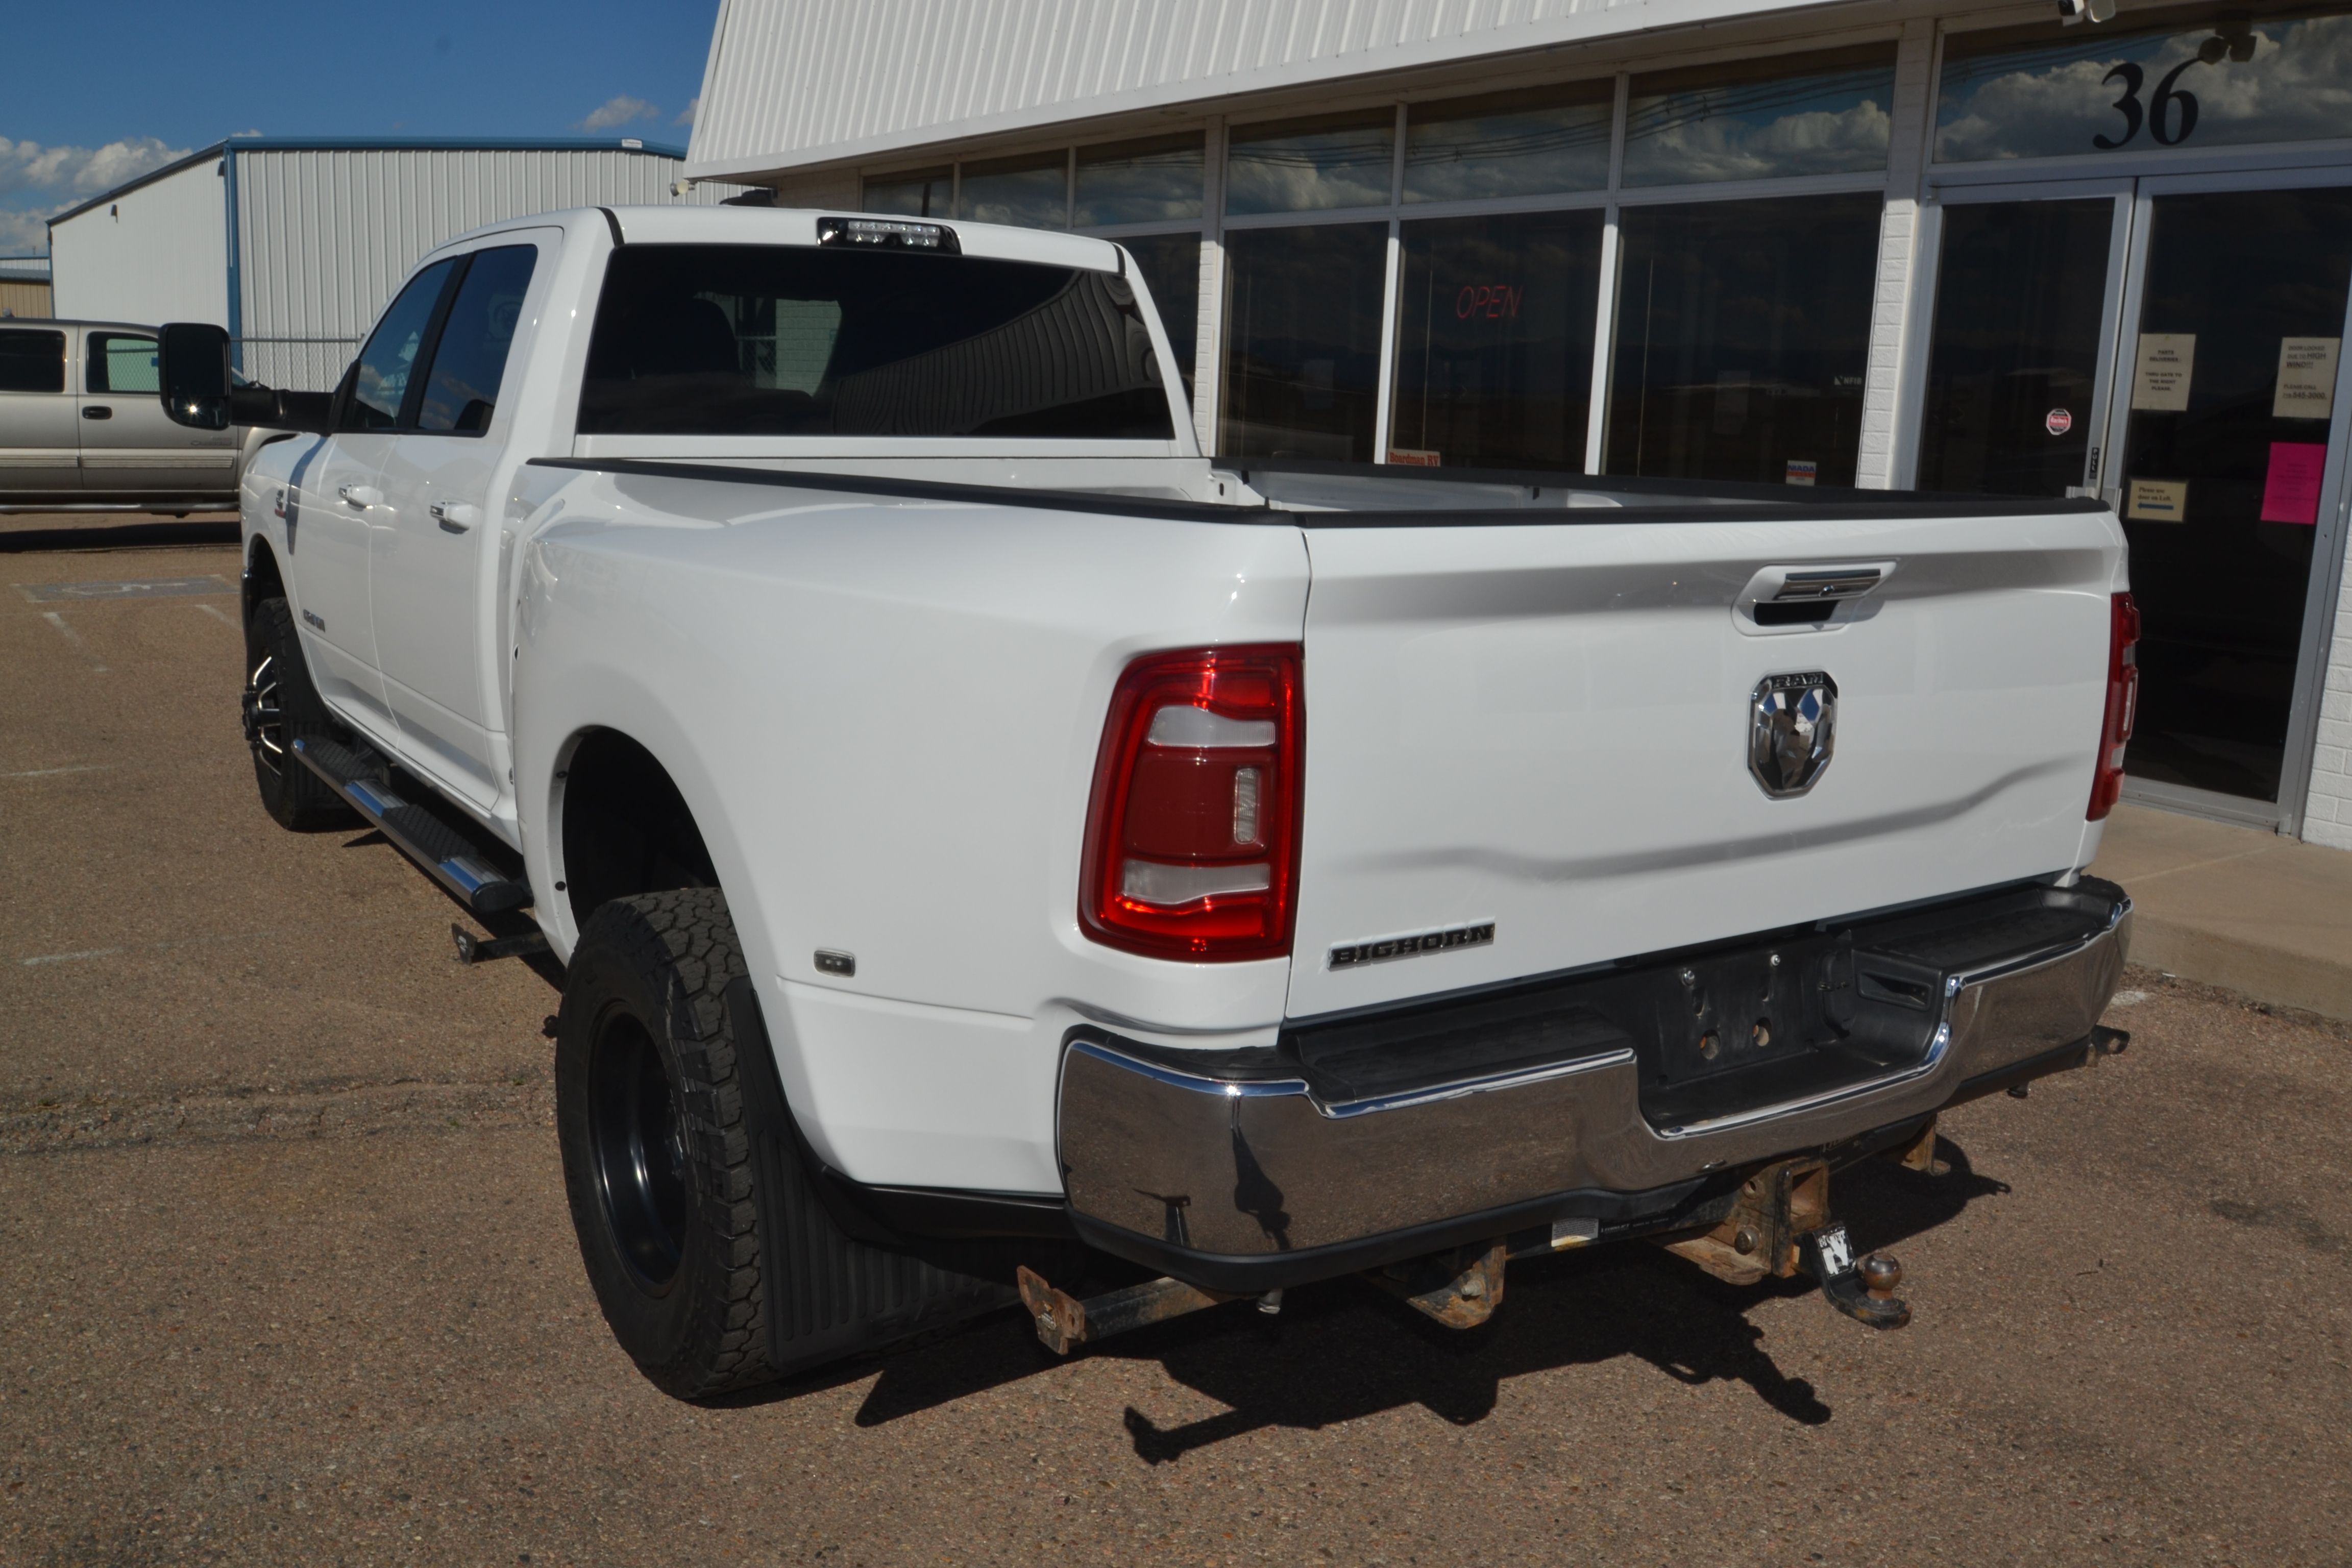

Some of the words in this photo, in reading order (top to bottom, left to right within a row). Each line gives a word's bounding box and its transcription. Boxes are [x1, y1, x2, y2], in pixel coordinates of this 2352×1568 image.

[2093, 57, 2203, 149] 36
[1456, 285, 1523, 318] OPEN
[1389, 452, 1426, 466] Boardman
[1427, 454, 1438, 466] RV
[1773, 673, 1824, 689] RAM
[1328, 922, 1495, 971] BIGHORN
